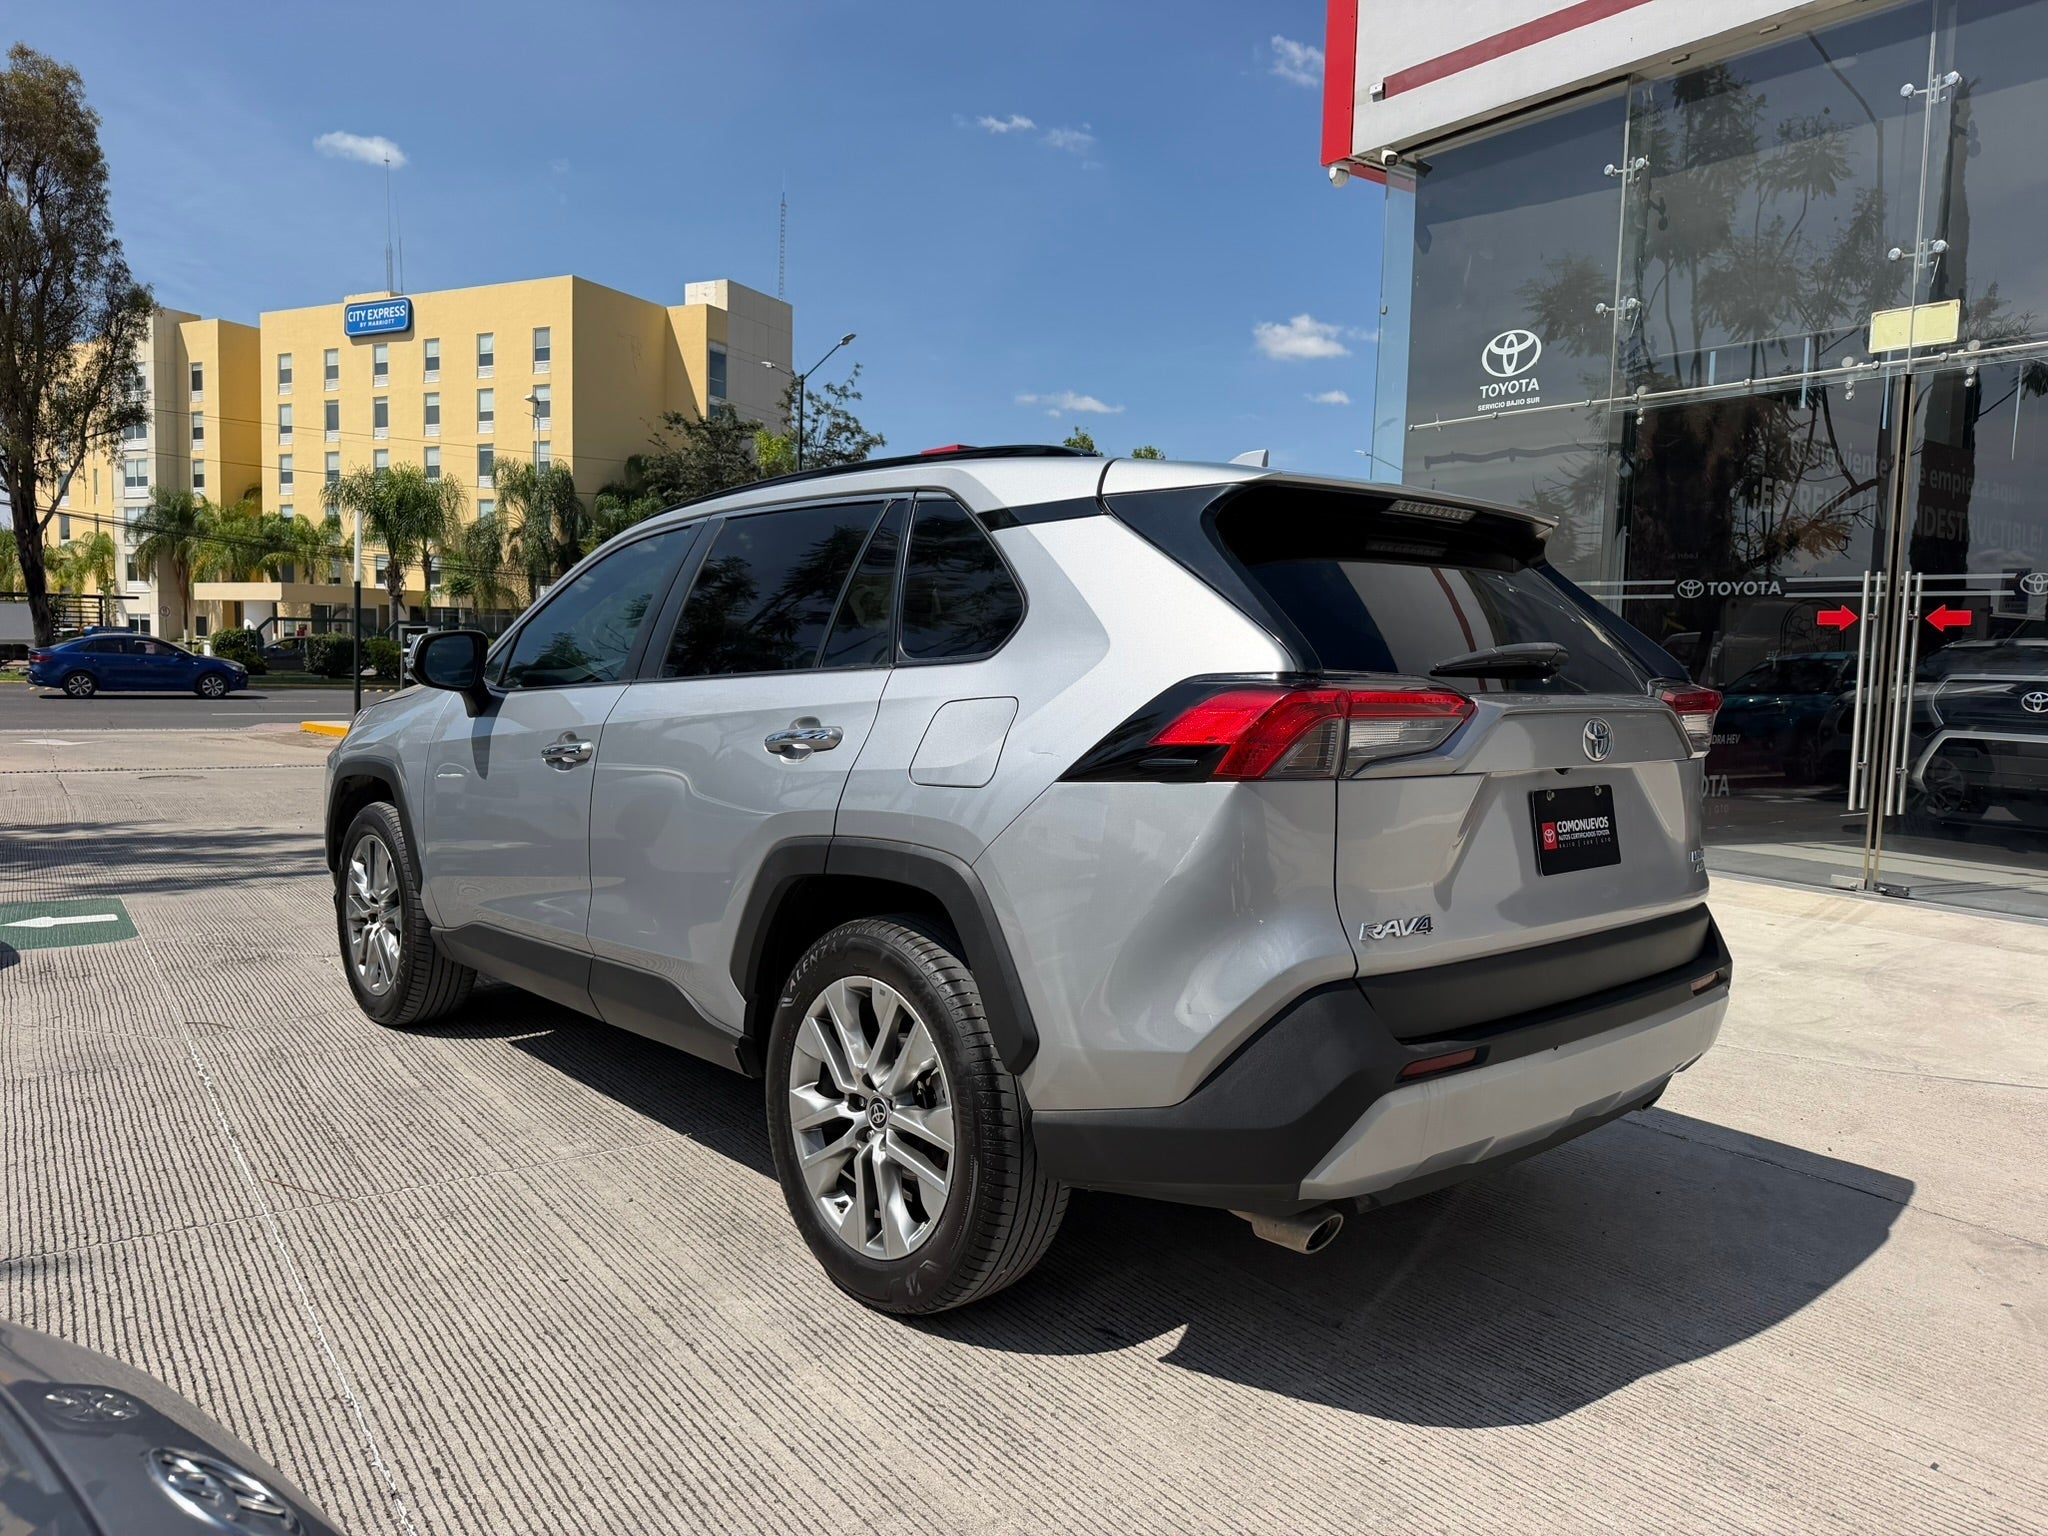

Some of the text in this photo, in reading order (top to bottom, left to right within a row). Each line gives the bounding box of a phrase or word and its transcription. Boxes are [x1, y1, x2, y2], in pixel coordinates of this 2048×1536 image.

[348, 305, 406, 322] CITY EXPRESS
[368, 319, 395, 327] MARRIOTT
[1480, 378, 1540, 399] TOYOTA
[1478, 402, 1505, 411] SERVICIO
[1506, 399, 1525, 407] BAJIO
[1913, 504, 2044, 554] NDESTRUCTIBLE!
[1706, 581, 1783, 596] TOYOTA
[1711, 733, 1741, 745] DRA HEV
[1557, 816, 1609, 833] COMONUEVOS
[1558, 833, 1571, 841] AUTOS
[1359, 914, 1434, 941] RAV4
[789, 940, 837, 993] ALENZA
